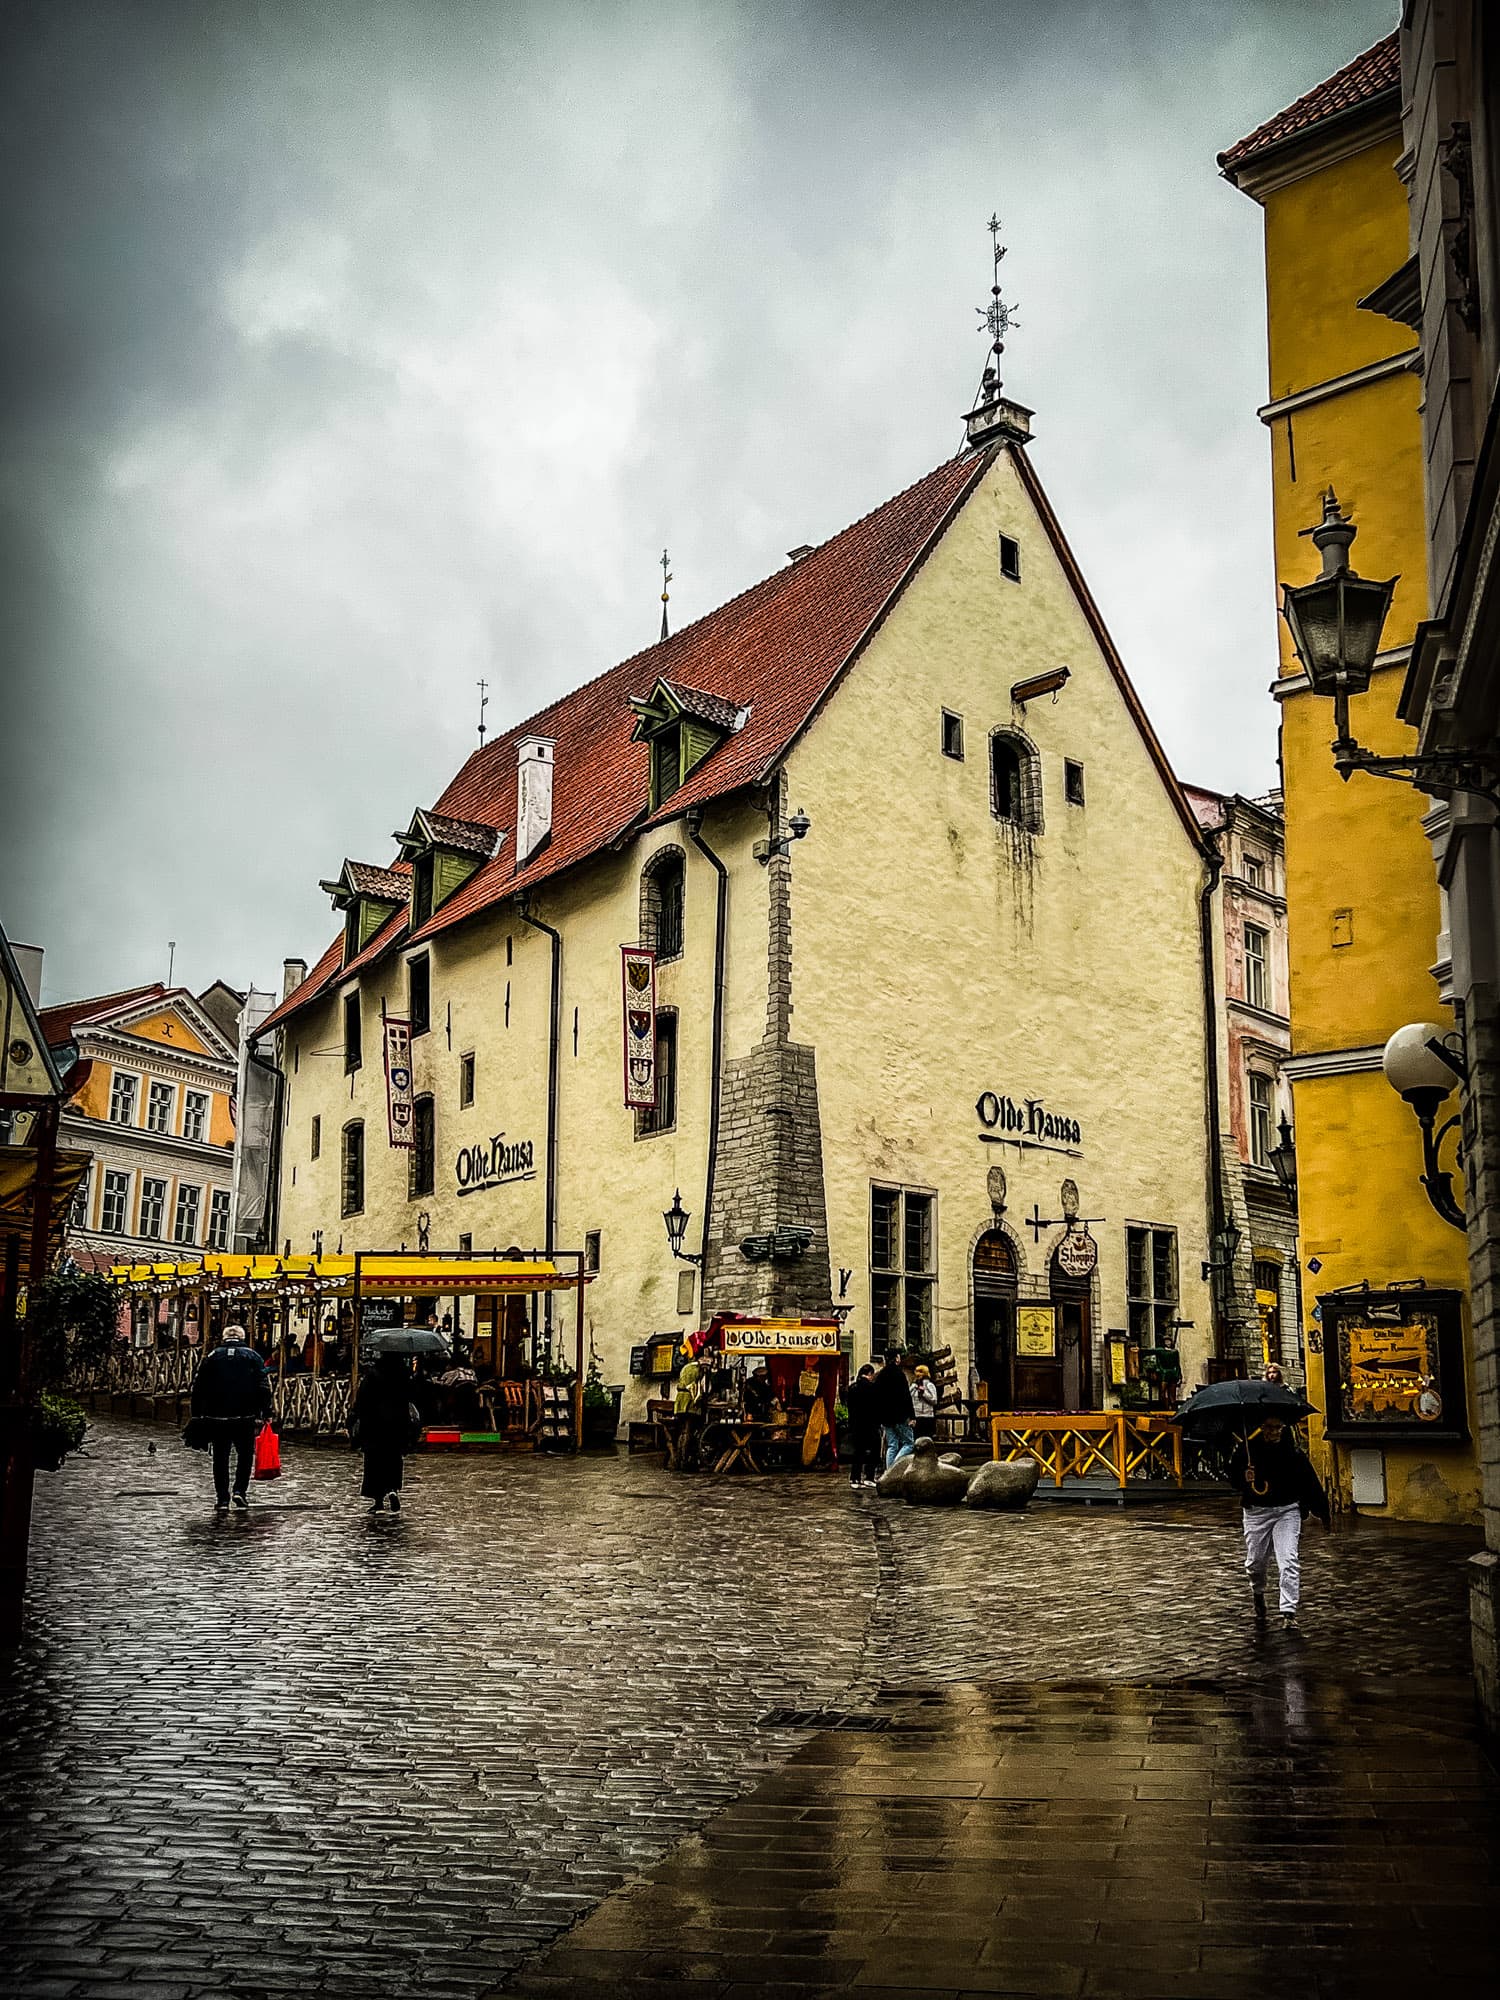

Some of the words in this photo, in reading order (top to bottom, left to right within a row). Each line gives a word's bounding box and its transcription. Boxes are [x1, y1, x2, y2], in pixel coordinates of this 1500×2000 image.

[975, 1091, 1024, 1131] Olde
[455, 1148, 489, 1187] Olde
[1060, 1247, 1095, 1266] Shoppe
[741, 1330, 771, 1345] Olde
